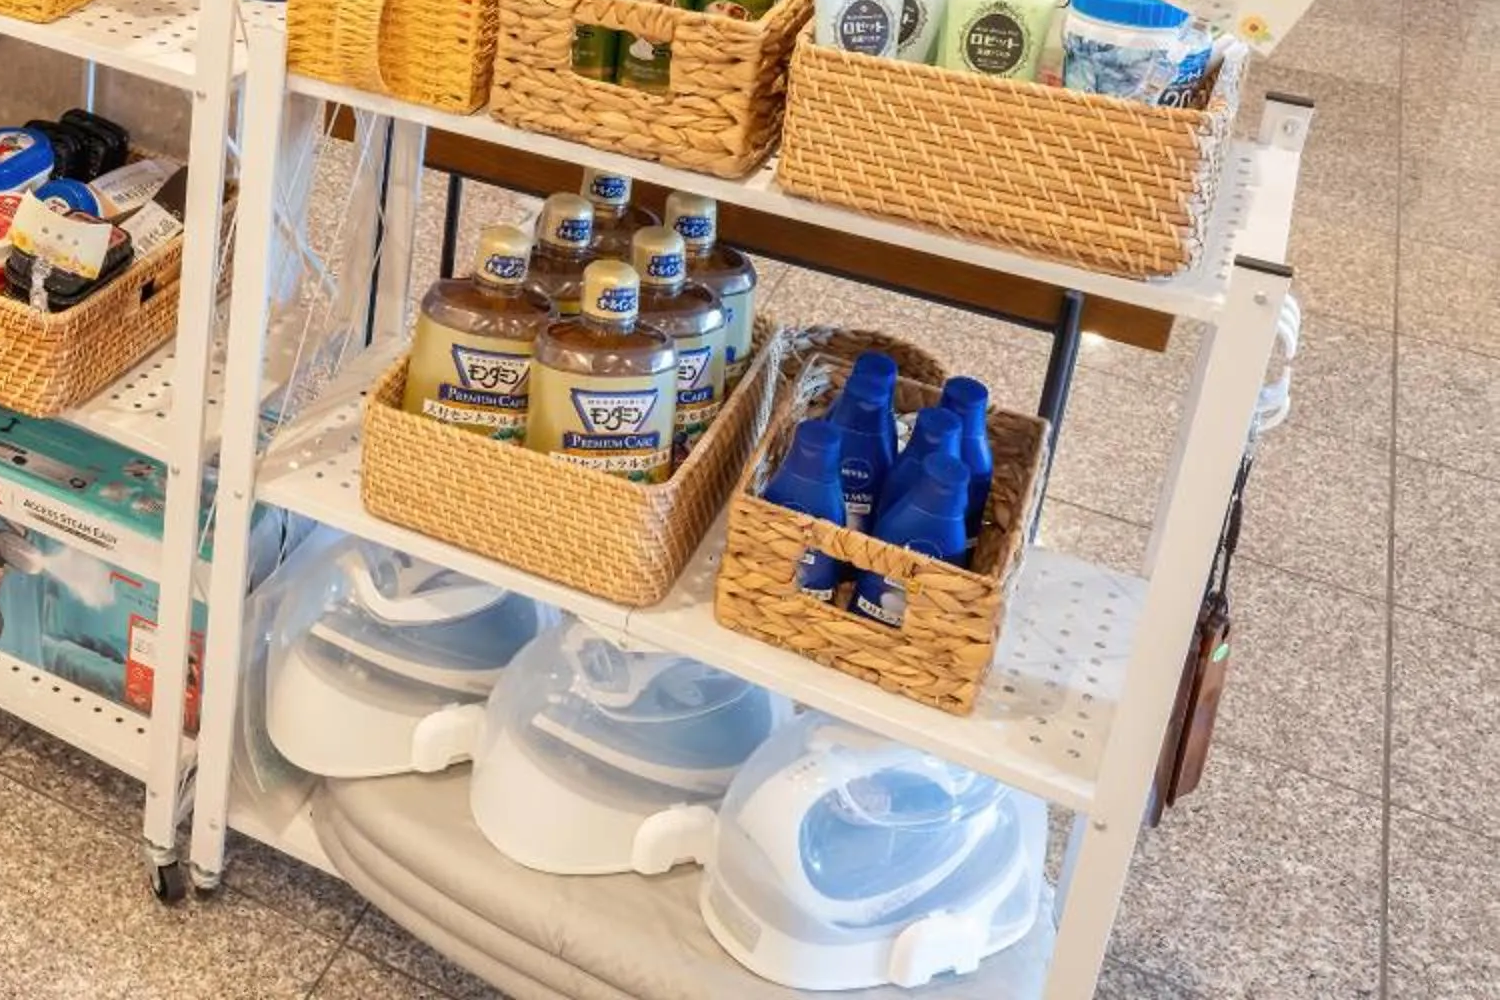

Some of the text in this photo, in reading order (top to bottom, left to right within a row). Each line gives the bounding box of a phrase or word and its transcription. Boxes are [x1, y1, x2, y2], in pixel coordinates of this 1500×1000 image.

[843, 21, 886, 35] ロゼット
[969, 33, 1020, 49] ロゼット
[468, 363, 520, 389] モンダミン
[449, 387, 497, 408] PREMIUM
[590, 407, 645, 431] モンダミン
[572, 434, 654, 448] PREMIUM CARE
[22, 498, 60, 521] ACCESS
[60, 512, 93, 534] STEAM
